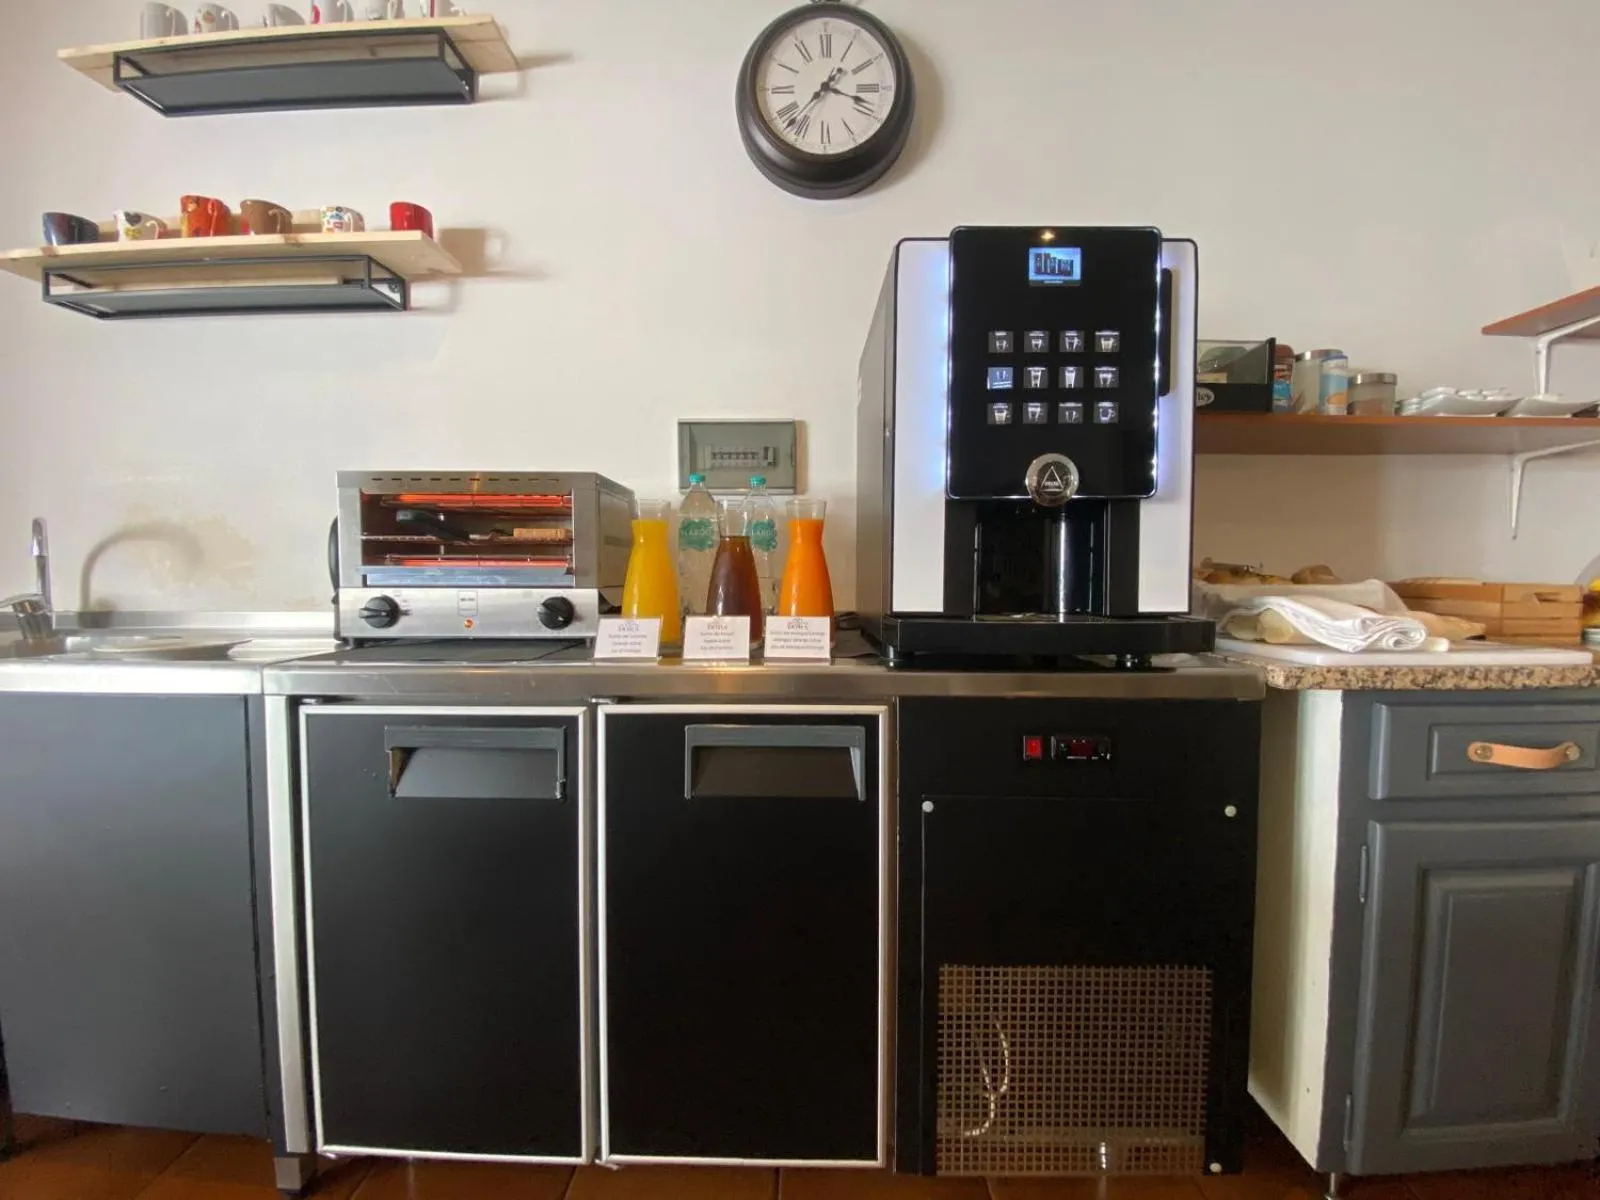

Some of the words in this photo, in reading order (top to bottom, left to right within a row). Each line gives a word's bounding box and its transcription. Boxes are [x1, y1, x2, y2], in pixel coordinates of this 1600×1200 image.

[840, 40, 853, 62] I
[851, 58, 874, 75] II
[855, 83, 880, 93] III
